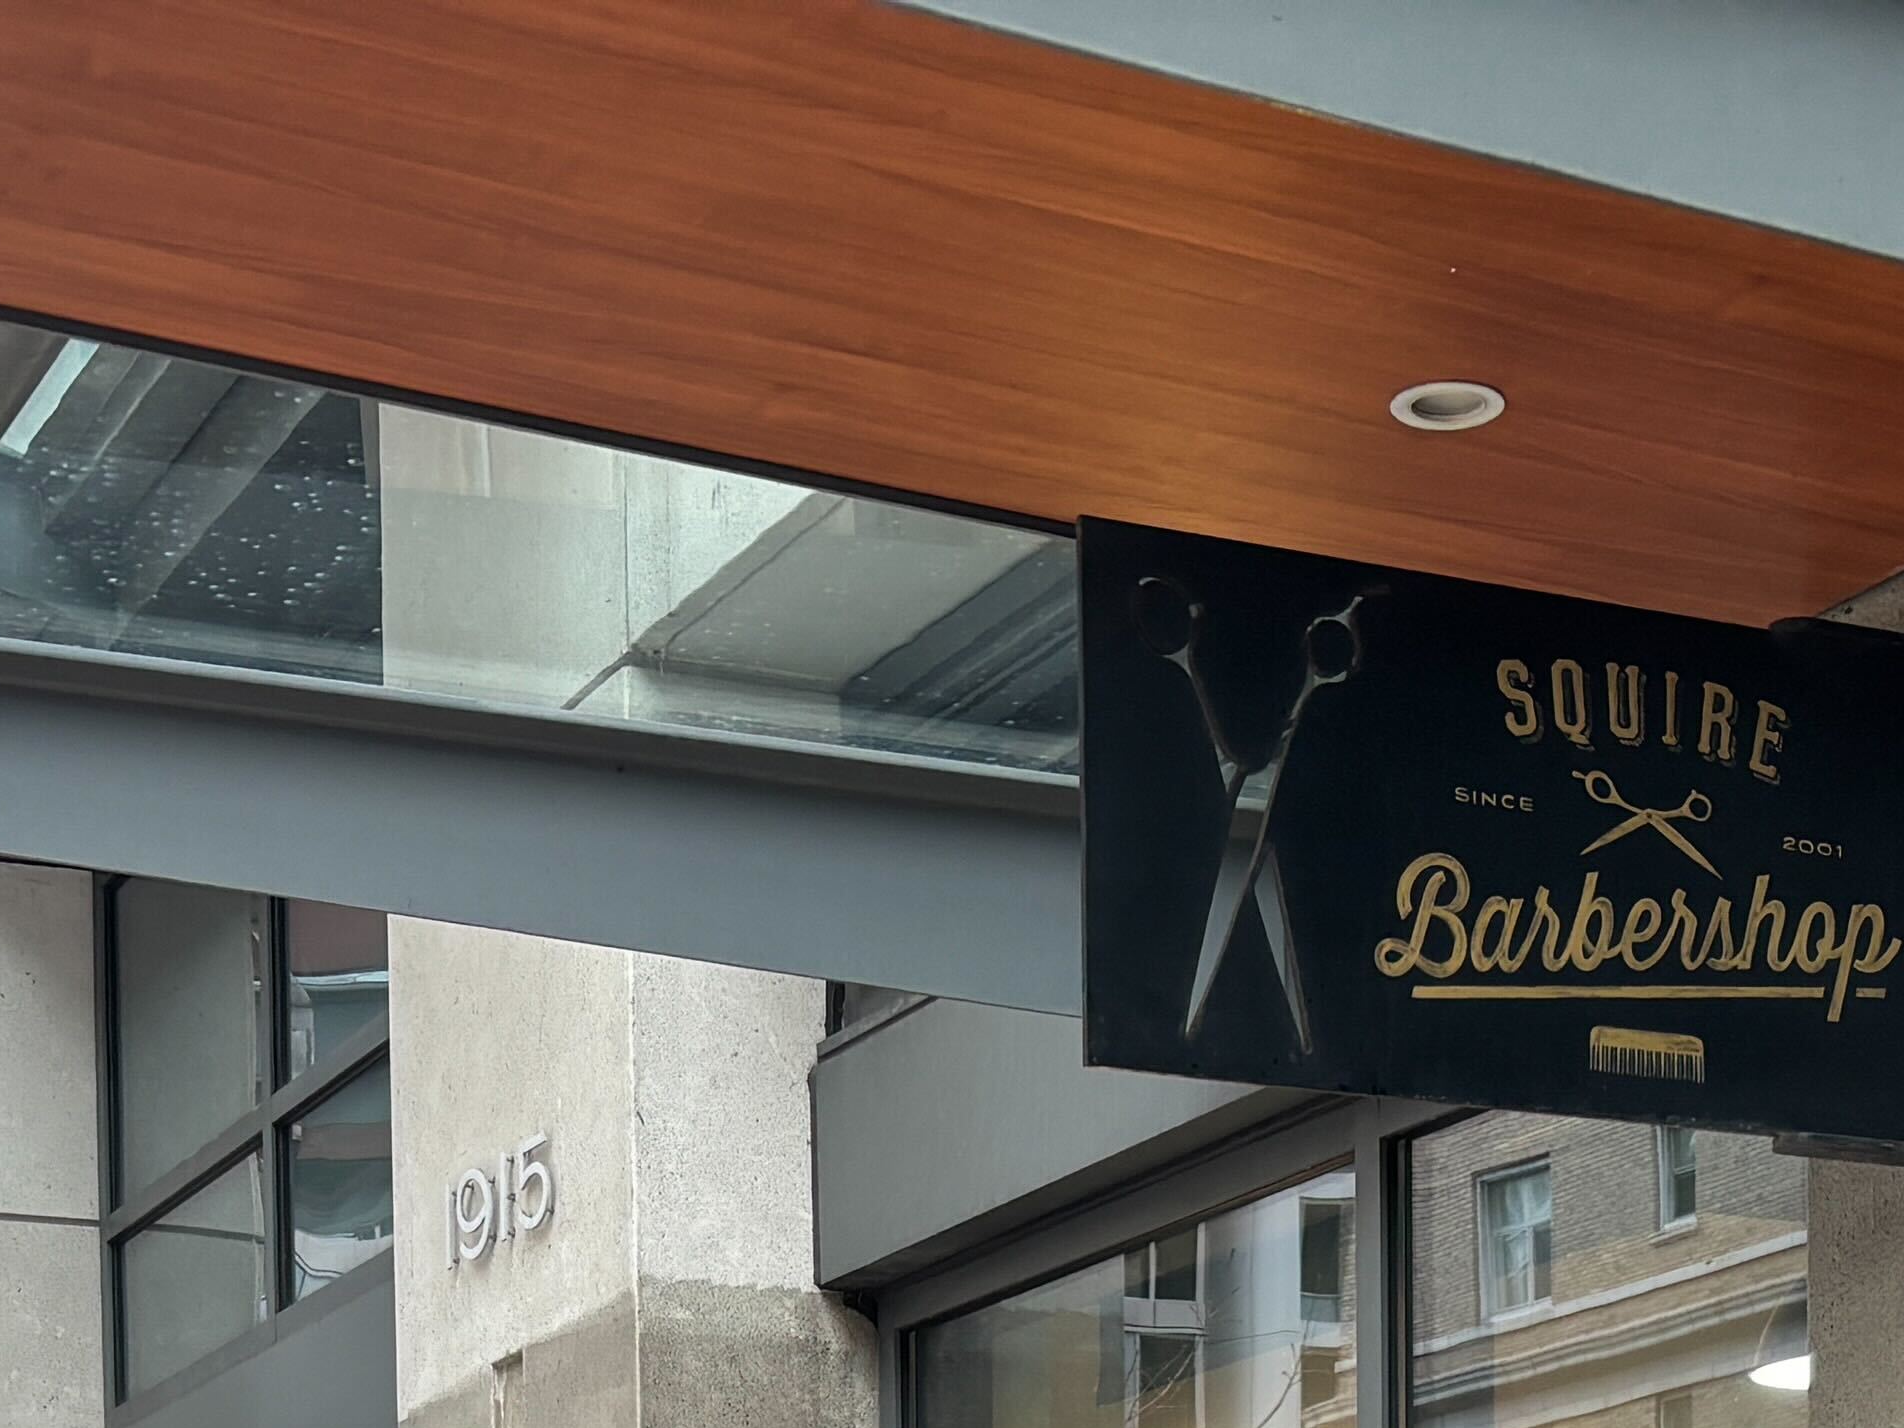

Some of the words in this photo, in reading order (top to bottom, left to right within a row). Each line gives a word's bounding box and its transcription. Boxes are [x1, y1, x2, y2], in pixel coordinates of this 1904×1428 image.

[1496, 658, 1790, 785] SQUIRE
[1454, 786, 1534, 812] SINCE
[1782, 836, 1843, 859] 2001
[1374, 851, 1902, 1023] Barbershop
